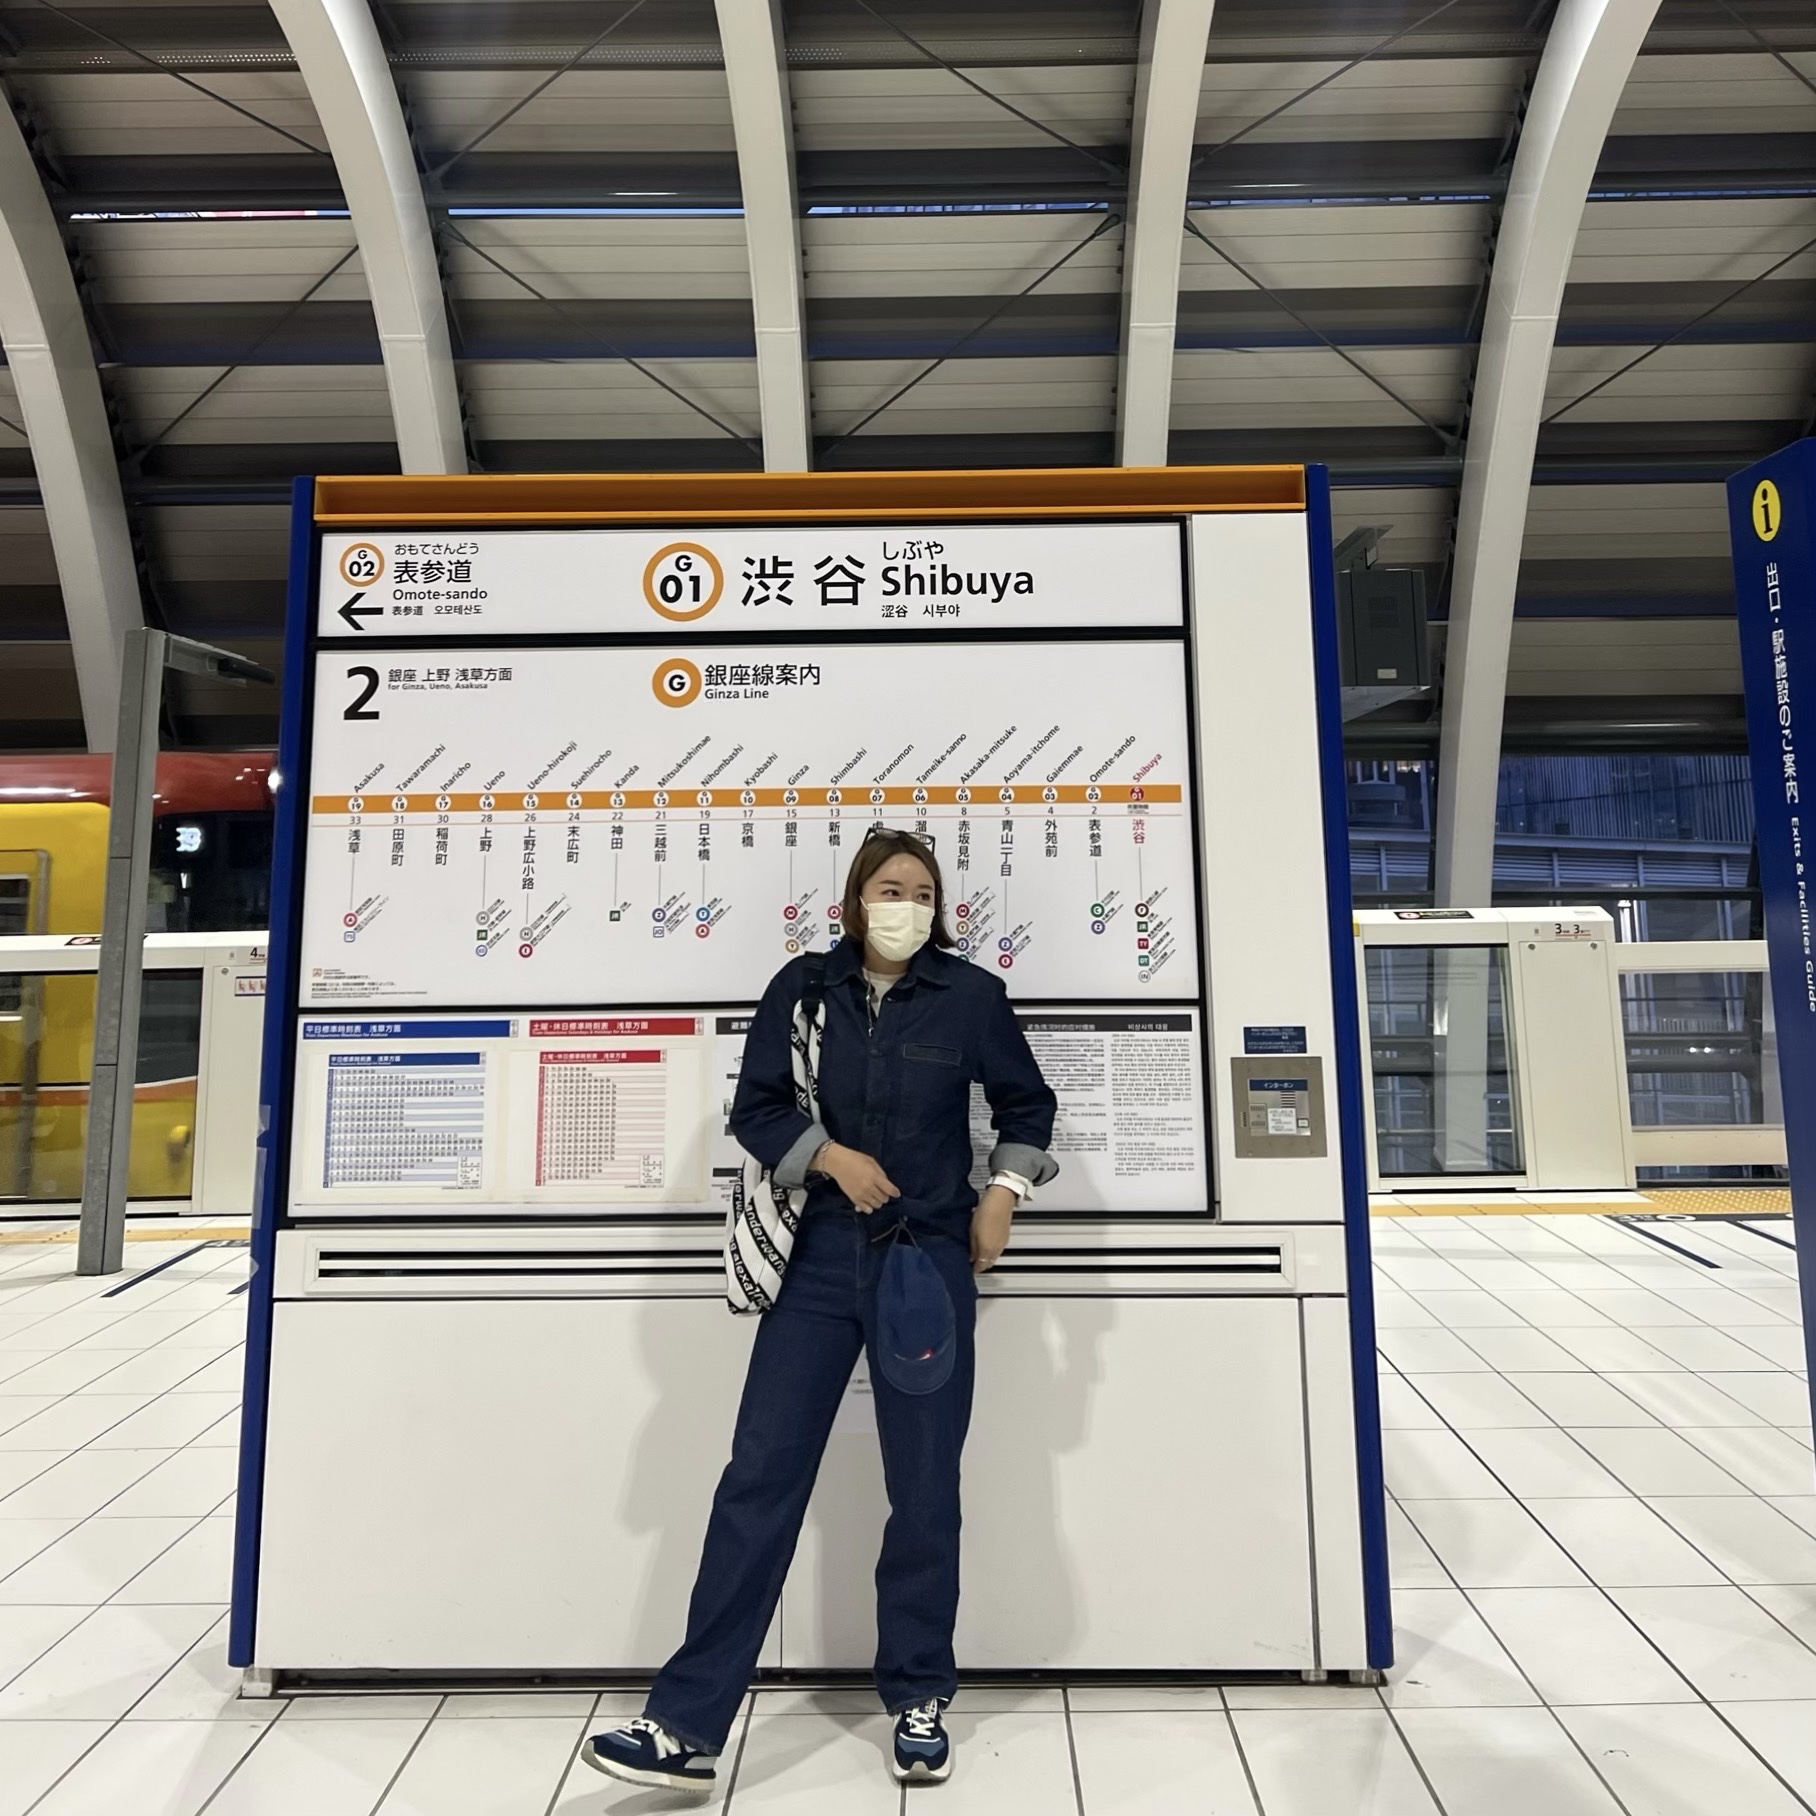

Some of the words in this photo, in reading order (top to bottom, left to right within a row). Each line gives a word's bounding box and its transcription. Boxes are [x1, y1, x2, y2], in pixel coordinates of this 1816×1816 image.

[358, 550, 367, 559] G
[395, 543, 479, 555] おもてさんどう
[883, 540, 944, 560] しぶや
[349, 561, 375, 577] 02
[393, 560, 472, 583] 表参道
[675, 555, 692, 572] G
[660, 575, 700, 603] 01
[741, 555, 866, 607] 渋谷
[882, 564, 1034, 603] Shibuya
[393, 588, 488, 600] Omote-sando
[392, 606, 423, 615] 表参道
[434, 605, 482, 614] 오모테산도
[923, 604, 960, 617] 시부야
[388, 669, 416, 682] 銀座
[422, 669, 450, 681] 上野
[455, 668, 512, 681] 浅草方面
[669, 674, 686, 691] G
[705, 663, 820, 686] 銀座線案内
[343, 666, 380, 720] 2
[705, 688, 739, 699] Ginza
[744, 689, 769, 698] Line
[657, 735, 711, 788] Mitsukoshimae
[873, 743, 914, 785] Toranomon
[916, 733, 967, 785] Tameike-sanno
[959, 724, 1017, 785] Akasaka-mitsuke
[1003, 724, 1060, 784] Aoyama-itchome
[1046, 745, 1084, 783] Gaiemmae
[1089, 735, 1136, 783] Omote-sando
[395, 744, 446, 792] Tawaramachi
[440, 761, 471, 792] Inaricho
[527, 741, 577, 790] Ueno-hirokoji
[571, 749, 612, 790] Suehirocho
[614, 764, 639, 789] Kanda
[701, 744, 744, 788] Nihombashi
[744, 752, 778, 787] Kyobashi
[787, 764, 810, 786] Ginza
[830, 748, 867, 786] Shimbashi
[1132, 752, 1163, 783] Shibuya
[354, 762, 385, 793] Asakusa
[484, 770, 506, 791] Ueno
[351, 802, 361, 810] 19
[395, 801, 405, 809] 18
[482, 800, 493, 808] 16
[612, 798, 623, 806] 13
[656, 797, 666, 805] 12
[699, 796, 709, 804] 11
[743, 796, 754, 804] 10
[828, 795, 840, 803] 08
[915, 794, 926, 802] 06
[349, 816, 361, 825] 33
[393, 815, 404, 824] 31
[438, 815, 449, 824] 30
[481, 814, 493, 823] 28
[524, 813, 536, 822] 26
[568, 812, 580, 821] 24
[611, 812, 623, 821] 22
[655, 811, 666, 820] 21
[699, 810, 711, 819] 19
[743, 810, 754, 818] 17
[786, 809, 797, 818] 15
[830, 808, 840, 817] 13
[873, 808, 883, 816] 11
[916, 808, 927, 816] 10
[961, 807, 967, 816] 8
[1004, 807, 1010, 815] 5
[1048, 806, 1054, 814] 4
[1091, 806, 1097, 814] 2
[348, 829, 360, 854] 浅草
[480, 827, 492, 852] 上野
[611, 825, 623, 849] 神田
[698, 824, 710, 861] 日本橋
[742, 823, 754, 848] 京橋
[785, 822, 797, 847] 銀座
[829, 822, 840, 846] 新橋
[1045, 820, 1058, 857] 外苑前
[1089, 819, 1102, 857] 表参道
[1133, 819, 1145, 844] 渋谷
[1791, 817, 1801, 858] Exits
[391, 829, 404, 866] 田原町
[436, 828, 448, 865] 稲荷町
[567, 826, 580, 863] 末広町
[655, 824, 667, 862] 三越前
[957, 820, 970, 871] 赤坂見附
[1000, 820, 1013, 876] 青山一丁目
[522, 827, 536, 890] 上野広小路
[1796, 862, 1804, 876] &
[1555, 923, 1562, 934] 3
[1573, 925, 1580, 933] 3
[1797, 881, 1811, 955] Facilities
[250, 947, 258, 957] 4
[1805, 960, 1816, 1013] Guide
